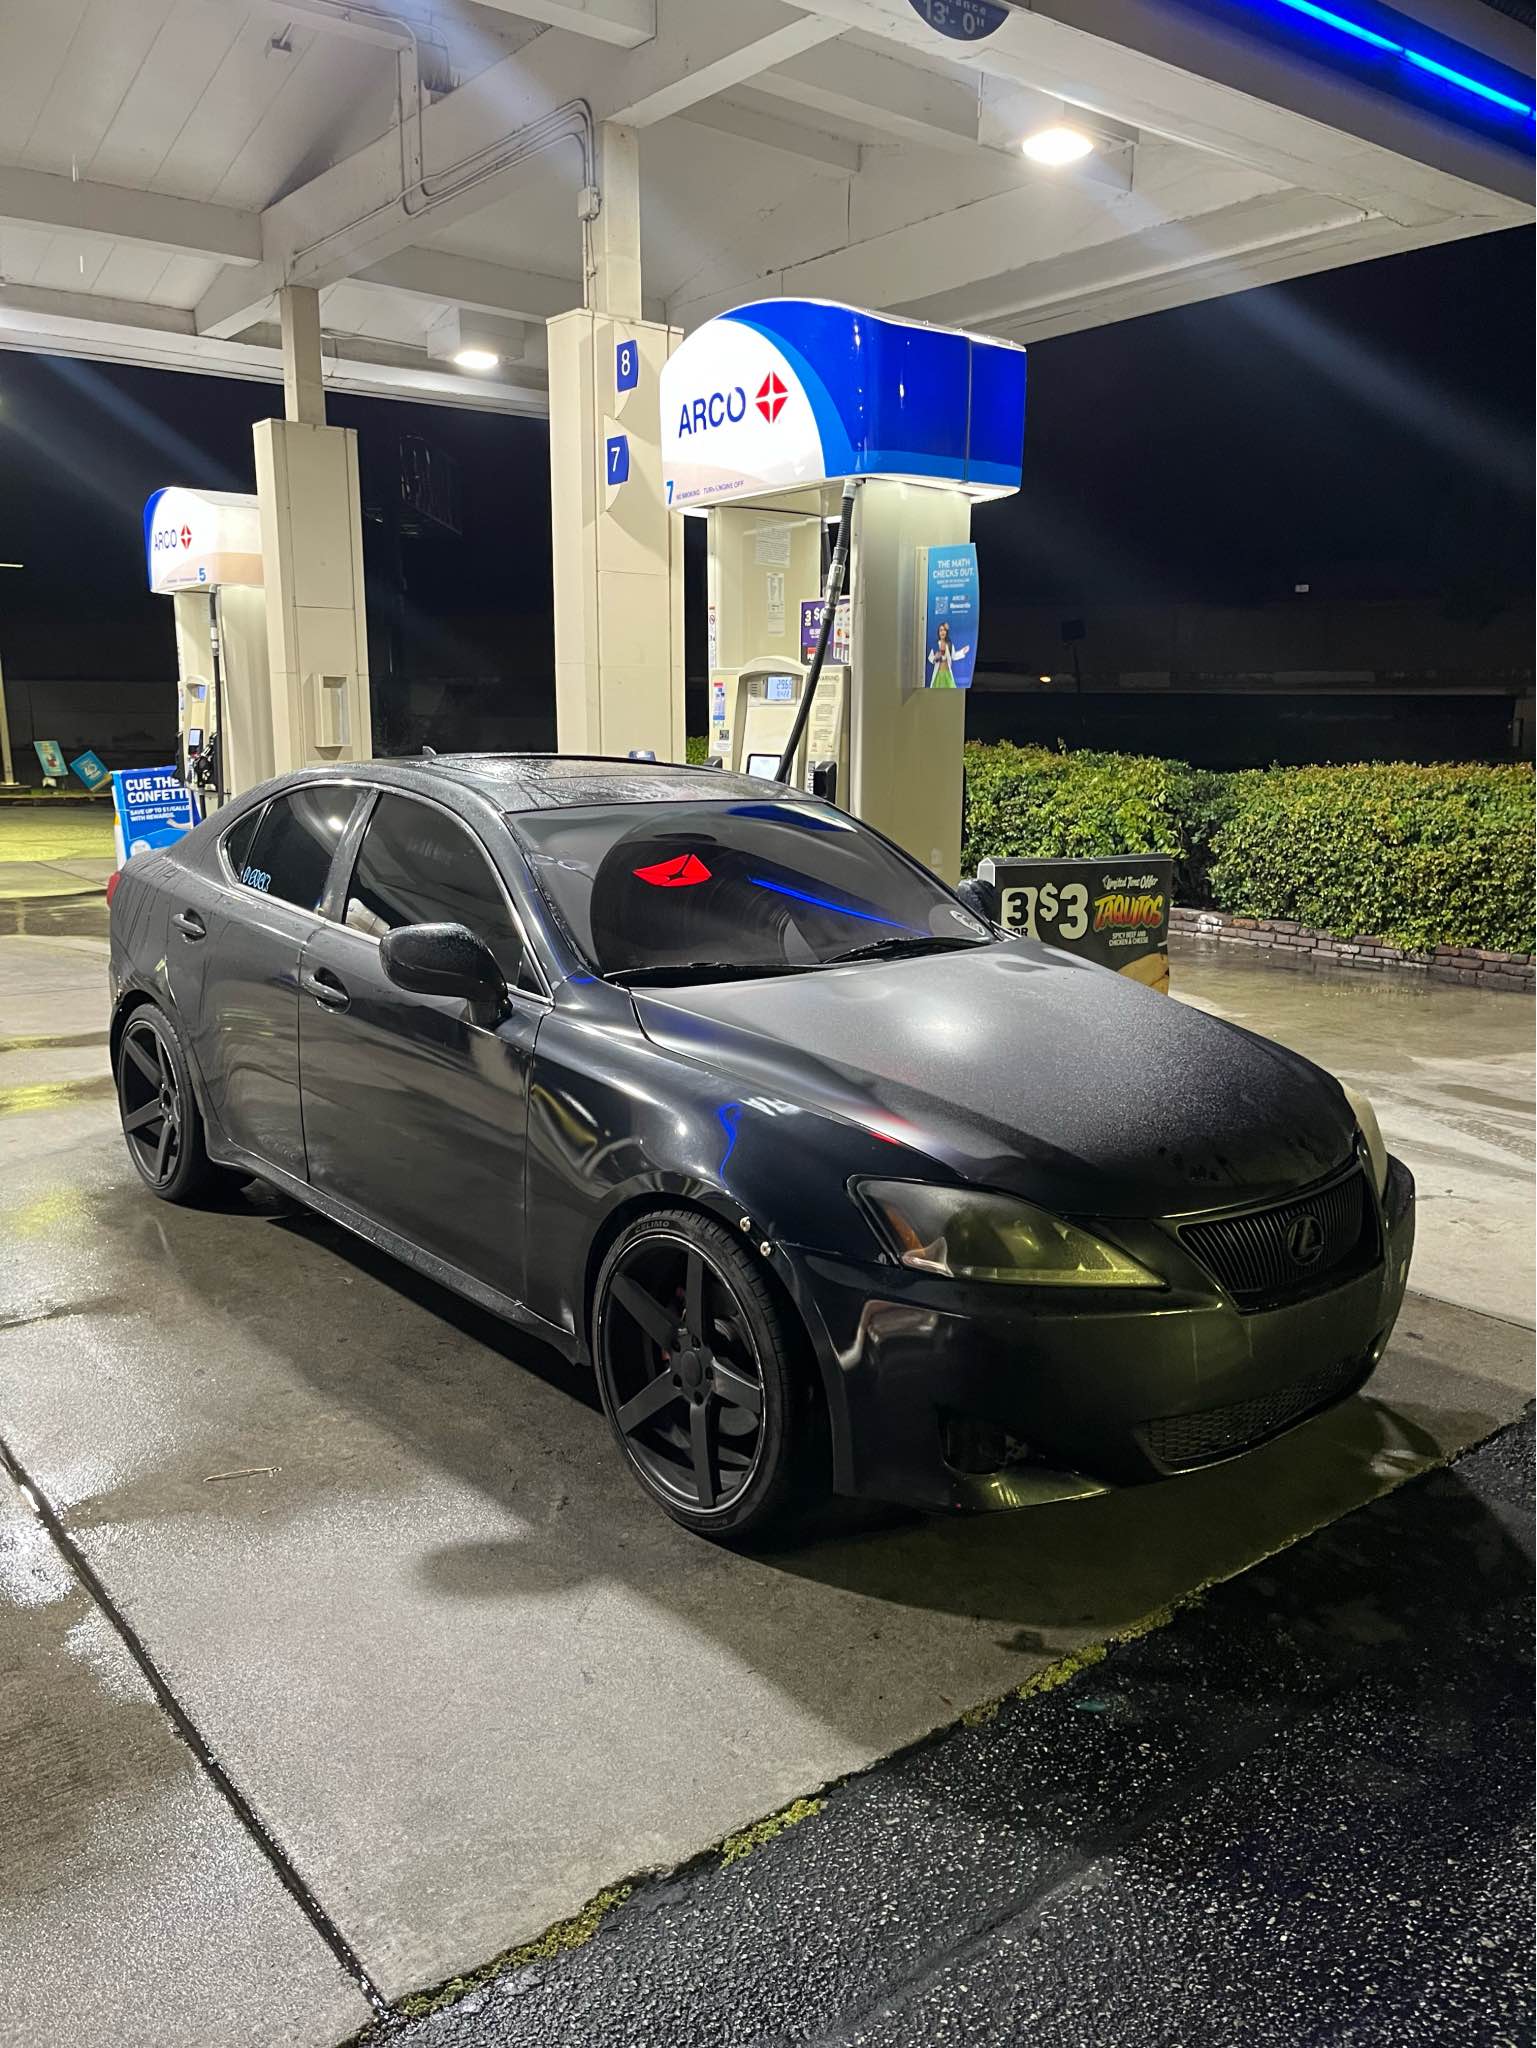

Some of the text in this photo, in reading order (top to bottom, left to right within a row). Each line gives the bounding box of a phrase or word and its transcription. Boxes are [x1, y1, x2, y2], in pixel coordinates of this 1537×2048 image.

[621, 349, 631, 376] 8
[679, 386, 746, 438] ARCO
[611, 446, 621, 473] 7
[666, 479, 674, 505] 7
[154, 529, 177, 551] ARCO
[198, 567, 207, 582] 5
[932, 569, 959, 579] CHECKS
[937, 559, 951, 569] THE
[125, 776, 180, 792] CUE THE
[1007, 892, 1029, 926] 3
[1039, 882, 1089, 940] $3
[1094, 894, 1163, 930] TAQUITOS
